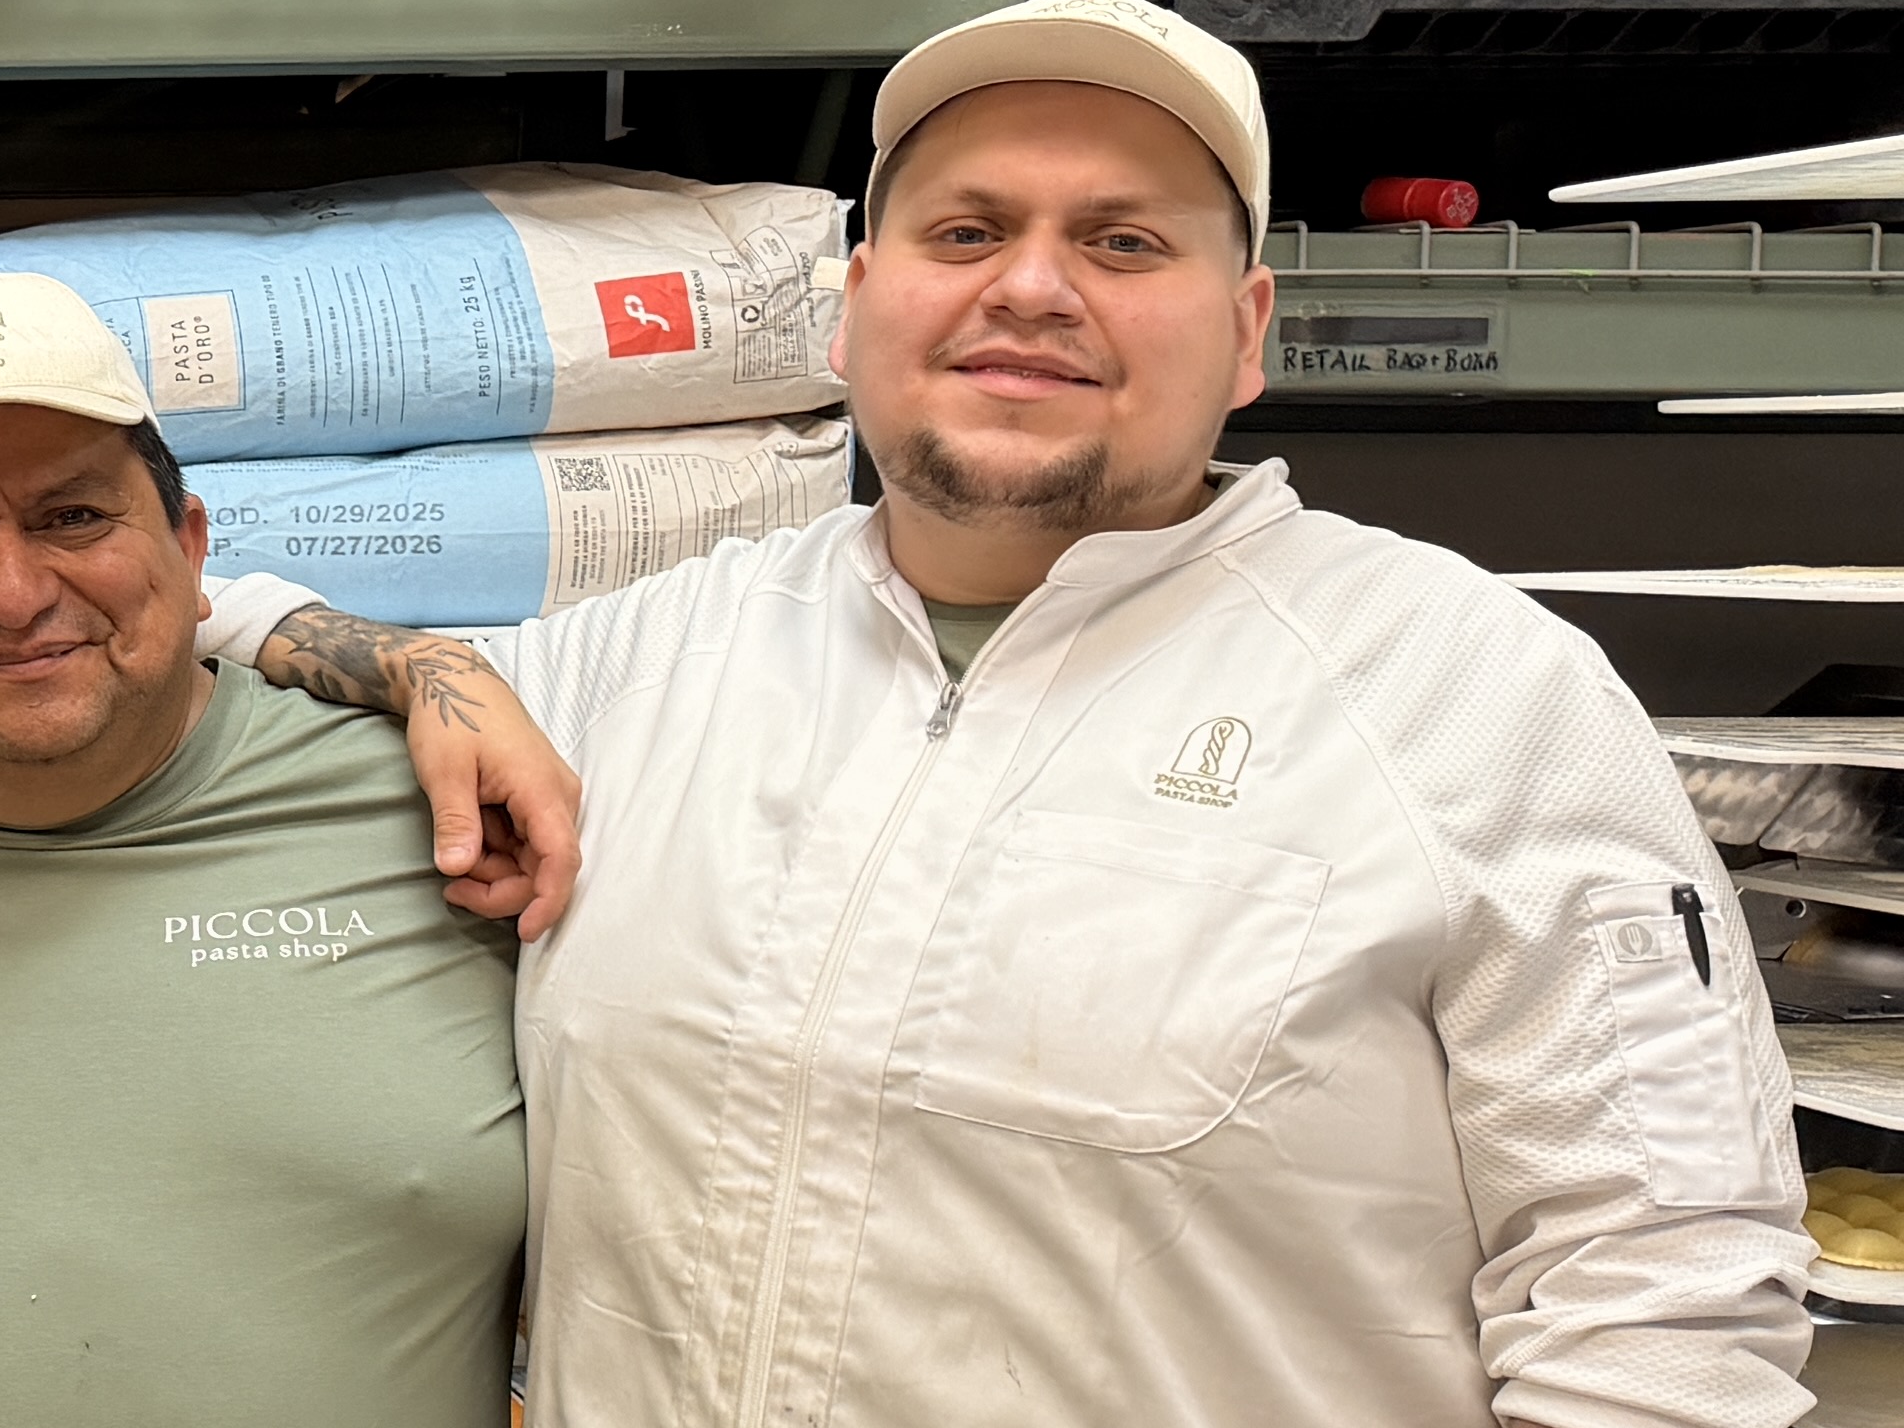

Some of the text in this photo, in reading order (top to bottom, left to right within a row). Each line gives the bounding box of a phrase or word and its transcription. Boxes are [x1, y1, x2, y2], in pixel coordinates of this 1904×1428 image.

[690, 269, 712, 350] MOLINO PASINI
[460, 275, 491, 398] PESO NETTO: 25 kg
[170, 320, 191, 382] PASTA
[1283, 348, 1372, 372] RETAIL
[207, 502, 446, 526] OD. 10/29/2025
[285, 535, 443, 556] 07/27/2026
[1154, 773, 1238, 800] PICCOLA
[1154, 787, 1194, 802] PASTA
[164, 907, 375, 943] PICCOLA
[191, 938, 348, 968] pasta shop
